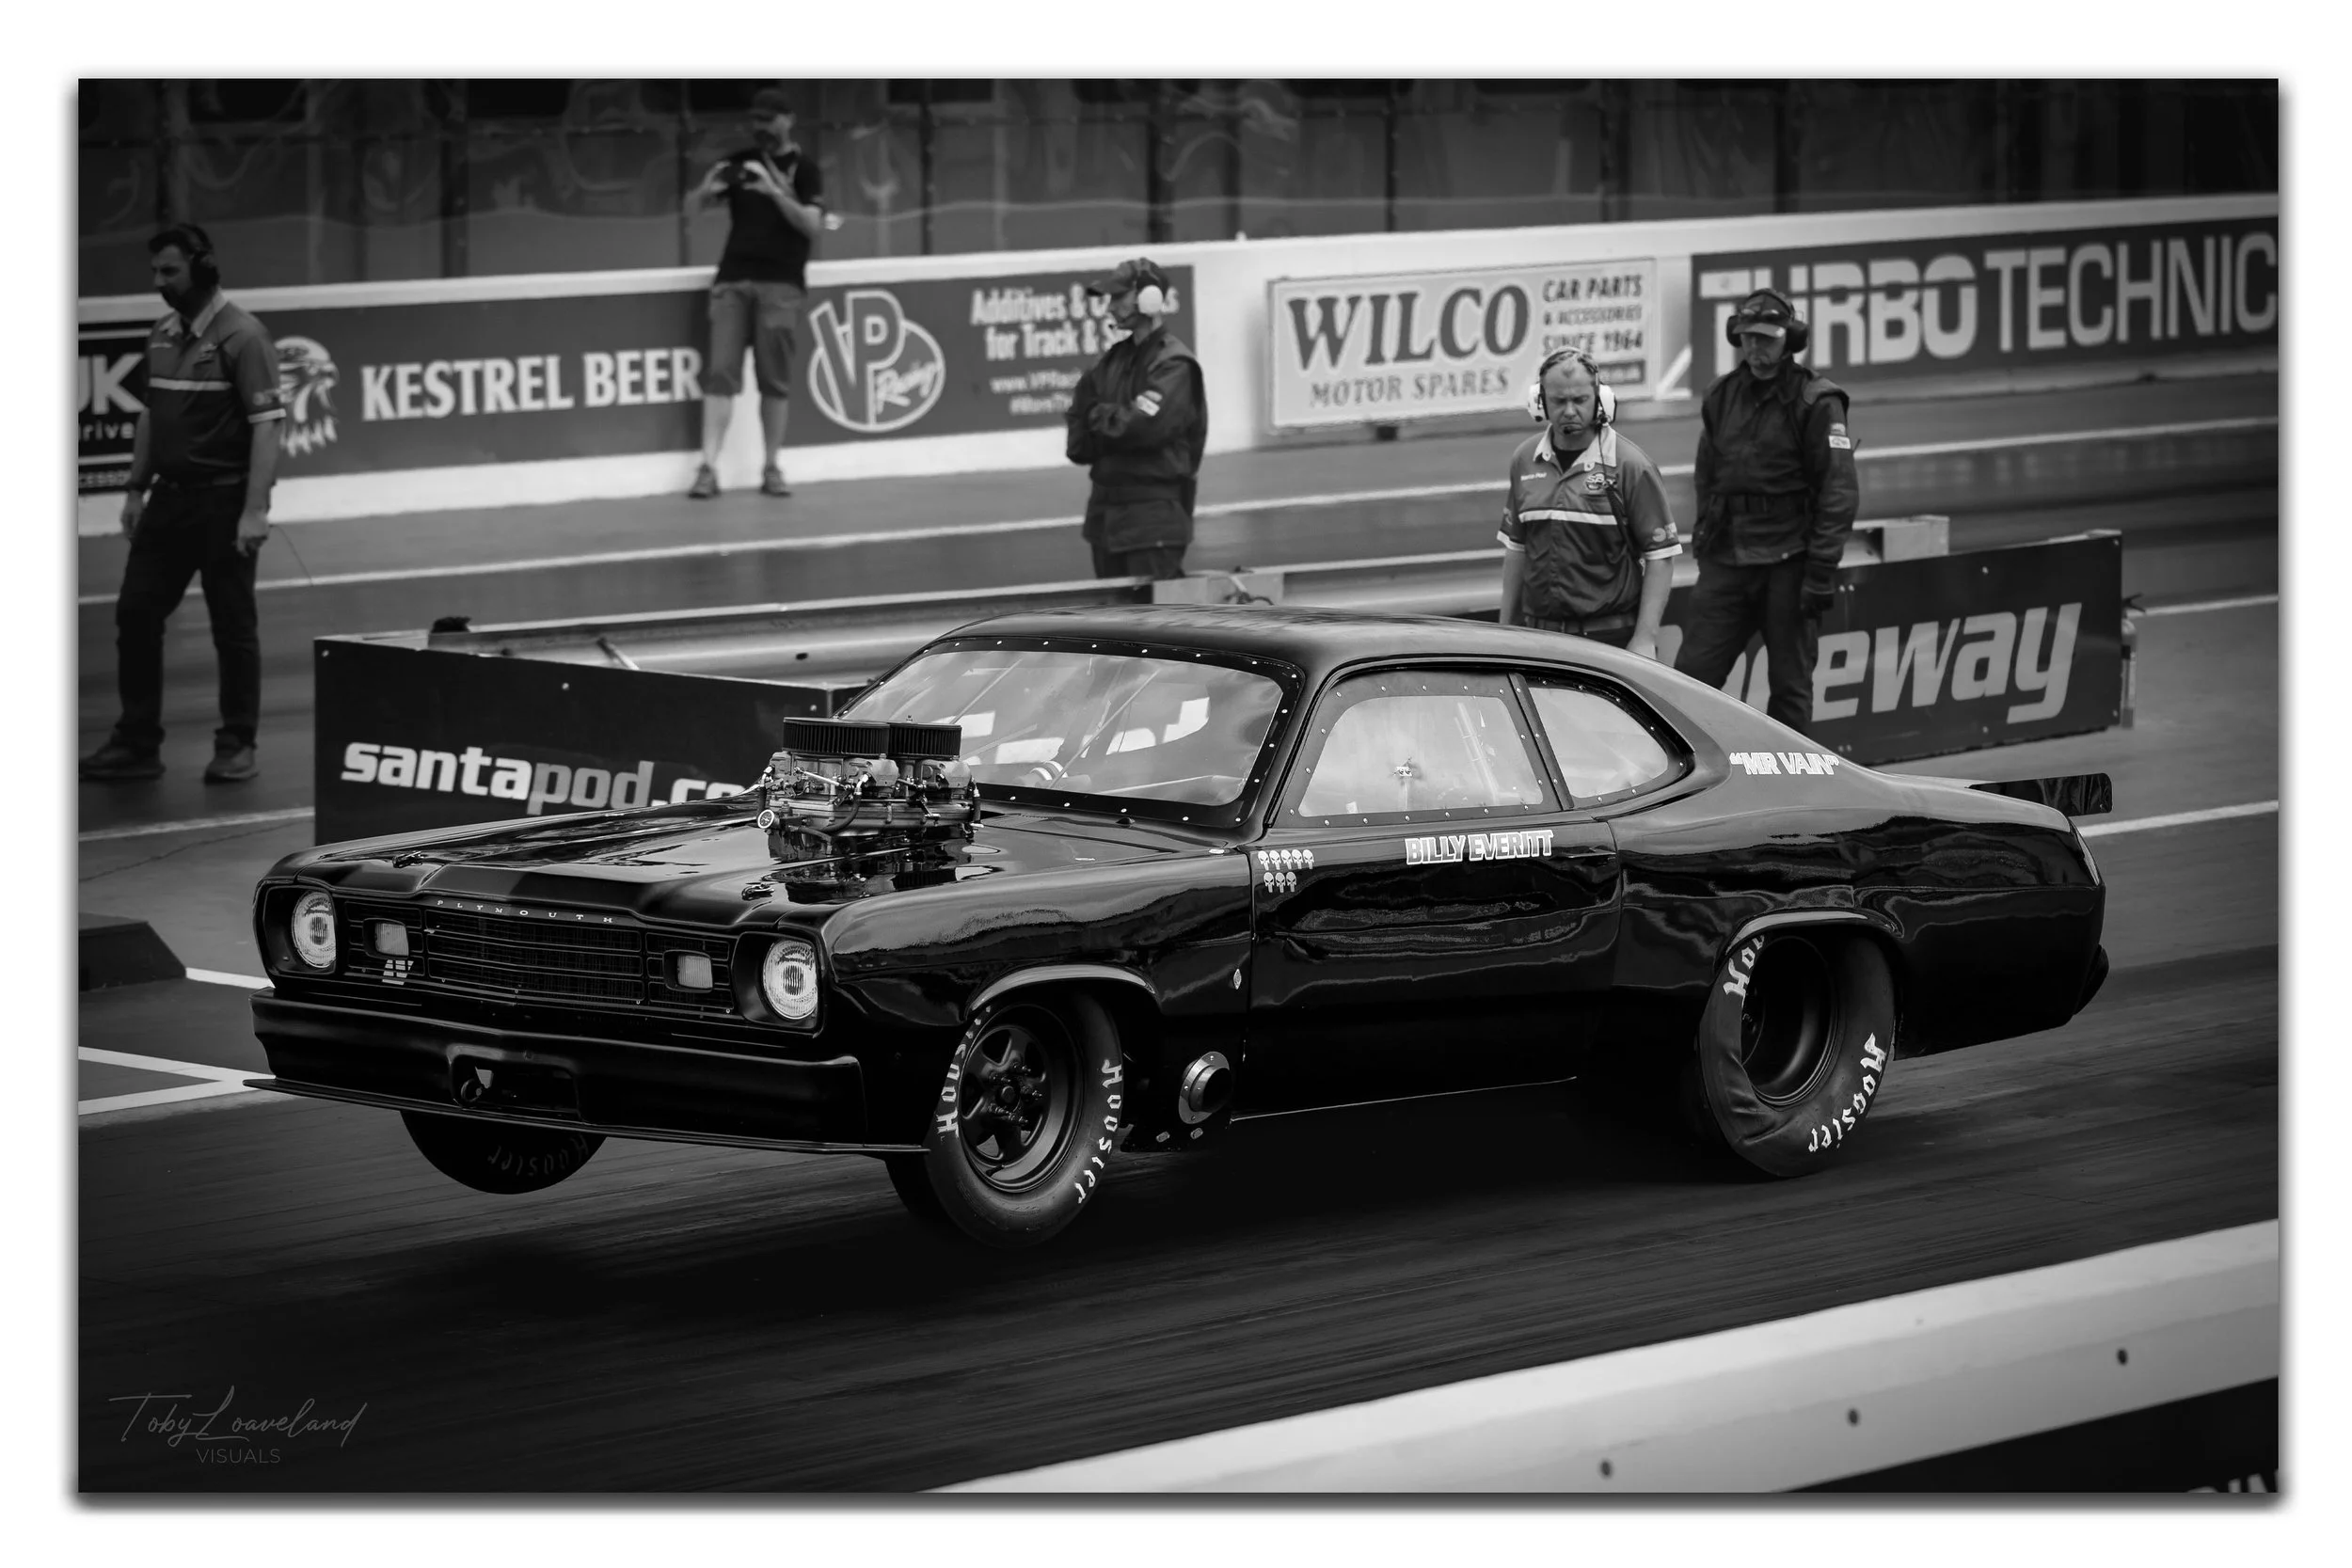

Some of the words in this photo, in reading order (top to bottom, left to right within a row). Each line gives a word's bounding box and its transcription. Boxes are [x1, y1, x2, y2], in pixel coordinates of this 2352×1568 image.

[970, 286, 1067, 325] Additives
[1543, 278, 1581, 302] CAR
[1586, 274, 1642, 298] PARTS
[1983, 232, 2278, 354] TECHNIC
[986, 325, 1018, 359] for
[1022, 321, 1079, 358] Track
[1288, 285, 1529, 371] WILCO
[361, 356, 574, 421] KESTREL
[583, 347, 704, 408] BEER
[1311, 375, 1402, 408] MOTOR
[1412, 367, 1509, 400] SPARES
[1405, 835, 1466, 865] BILLY
[1469, 830, 1554, 862] EVERITT
[437, 899, 614, 925] PLYMOUTH
[1808, 1032, 1886, 1153] Hoosier
[1074, 1058, 1123, 1204] Hoosier
